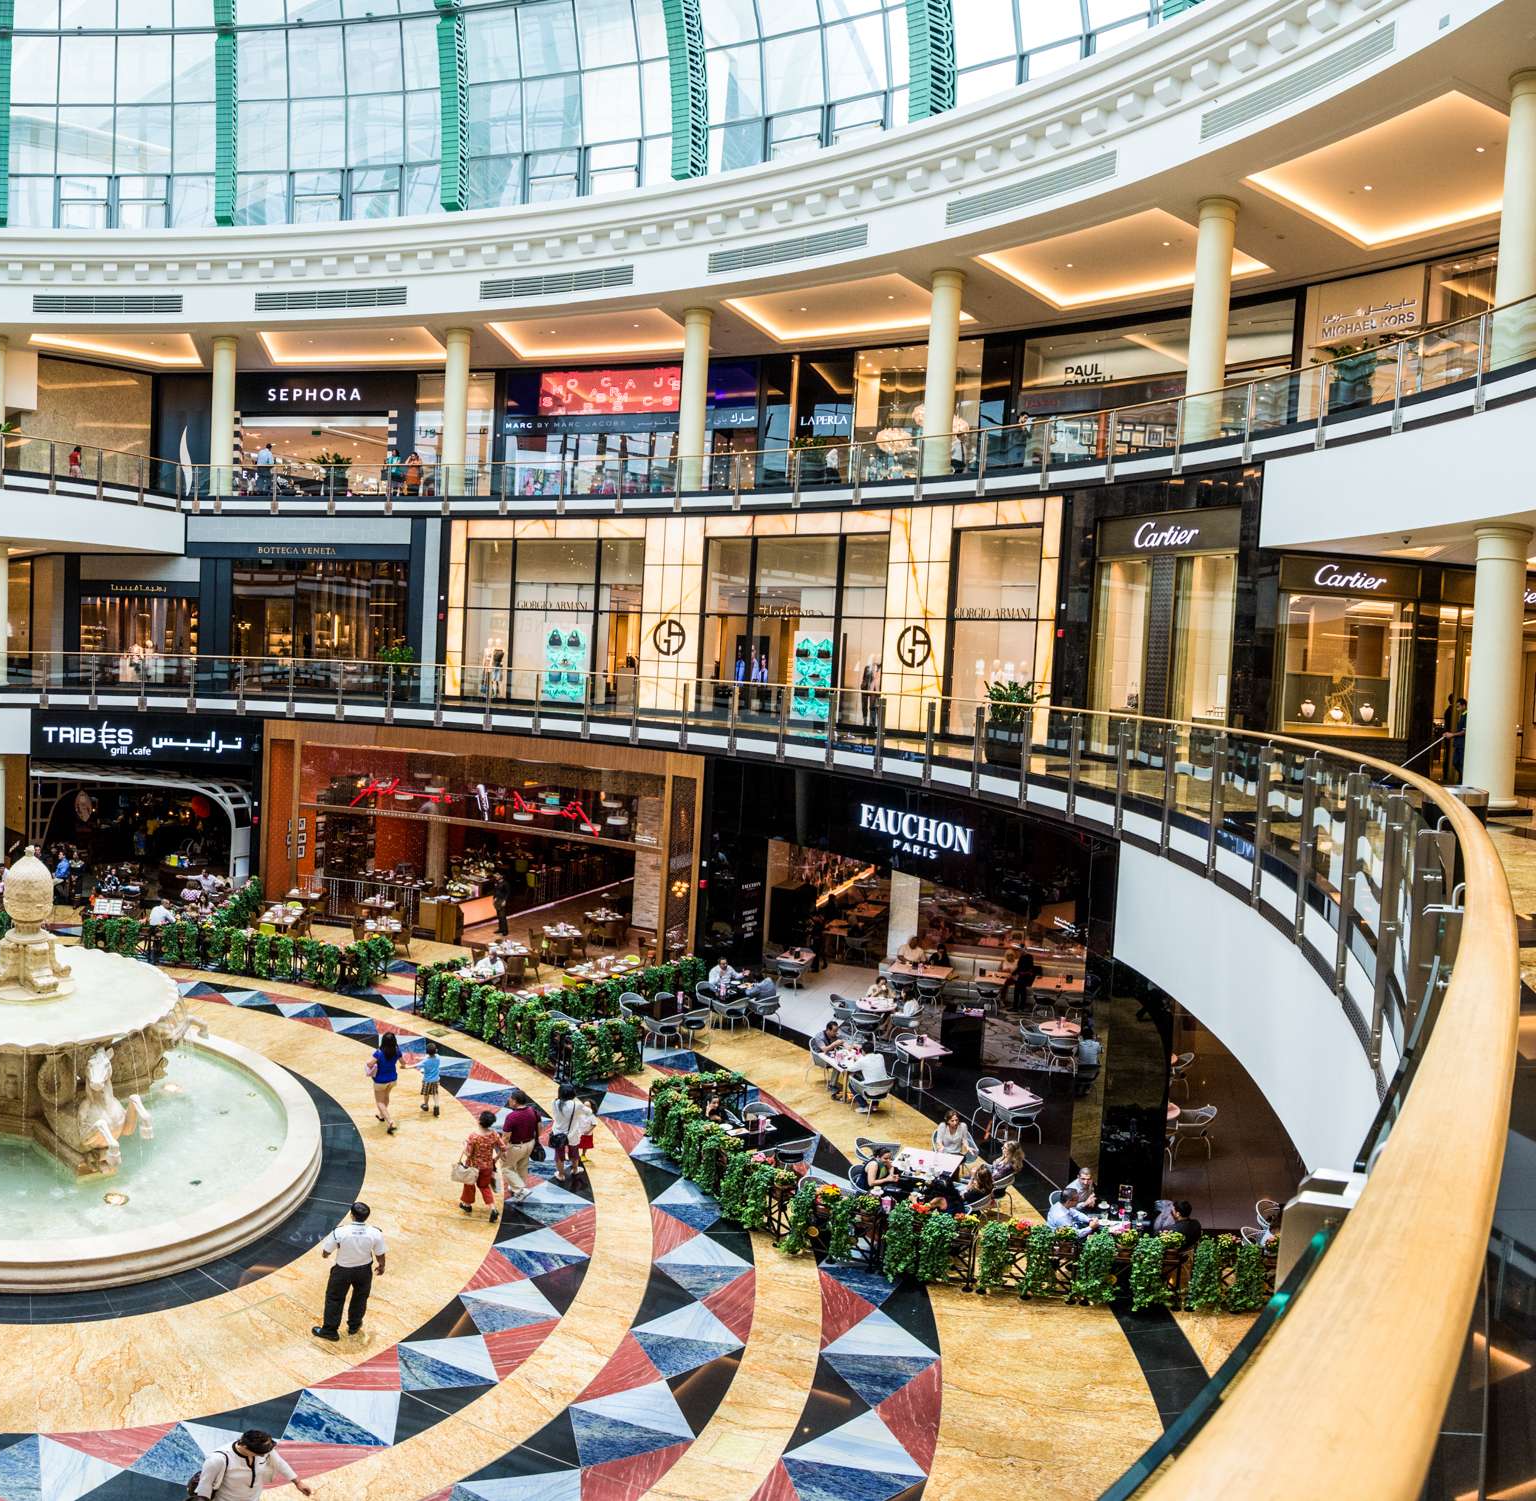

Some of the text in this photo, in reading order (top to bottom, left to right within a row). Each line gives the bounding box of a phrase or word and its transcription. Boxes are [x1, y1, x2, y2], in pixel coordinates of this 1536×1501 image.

[1321, 319, 1377, 338] MICHAEL
[1064, 362, 1103, 378] PAUL
[267, 387, 362, 402] SEPHORA
[1134, 522, 1200, 549] Cartier
[257, 546, 337, 556] BOTTEGA VENETA
[1313, 564, 1387, 591] Cartier
[994, 607, 1031, 619] ARMANI
[42, 720, 134, 750] TRIBES
[151, 730, 243, 754] ترايبس
[110, 746, 128, 757] grill
[859, 803, 974, 855] FAUCHON
[892, 839, 938, 860] PARIS
